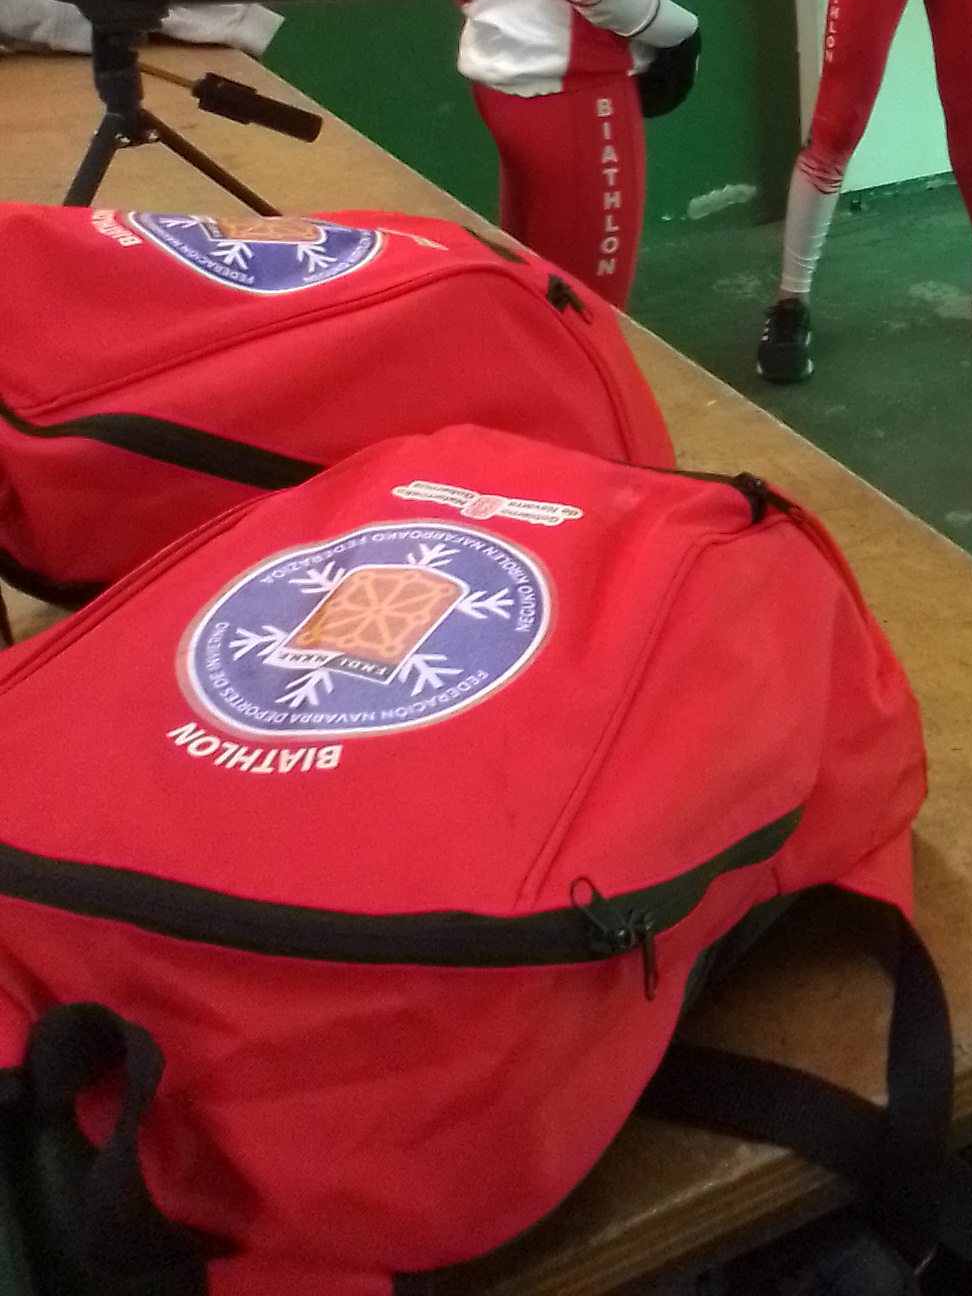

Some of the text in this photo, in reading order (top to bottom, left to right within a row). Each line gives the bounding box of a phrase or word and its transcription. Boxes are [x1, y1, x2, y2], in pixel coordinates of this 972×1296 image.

[597, 98, 621, 276] BIATHLON
[259, 535, 368, 584] FEDERAZIOA
[514, 584, 537, 633] NEGUKO
[209, 671, 230, 689] DE
[219, 687, 290, 724] DEPORTES
[289, 710, 377, 724] NAVARRA
[166, 721, 344, 774] BIATHLON
